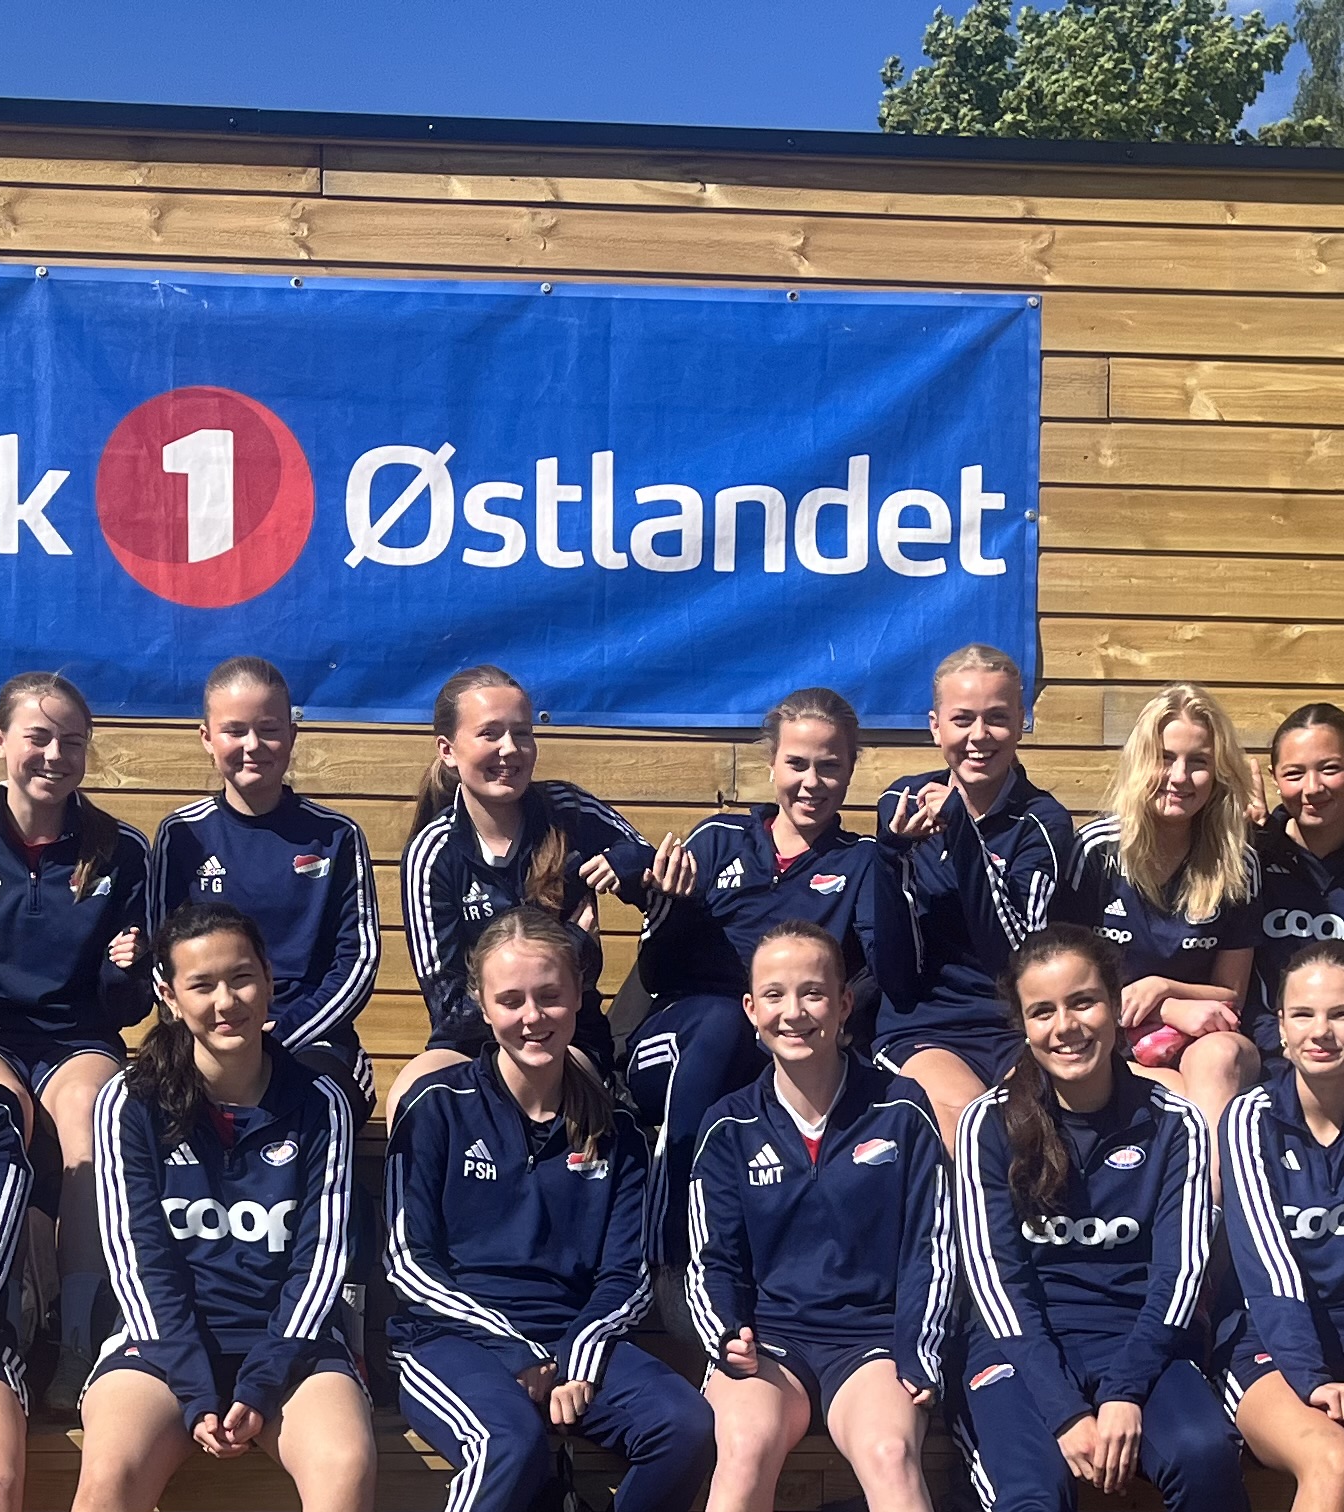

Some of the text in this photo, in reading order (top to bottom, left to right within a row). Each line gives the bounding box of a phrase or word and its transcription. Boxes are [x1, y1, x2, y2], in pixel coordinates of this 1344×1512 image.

[162, 427, 235, 564] 1
[343, 441, 1007, 578] Østlandet
[717, 875, 741, 889] WA
[463, 1159, 497, 1181] PSH
[748, 1165, 785, 1187] LMT
